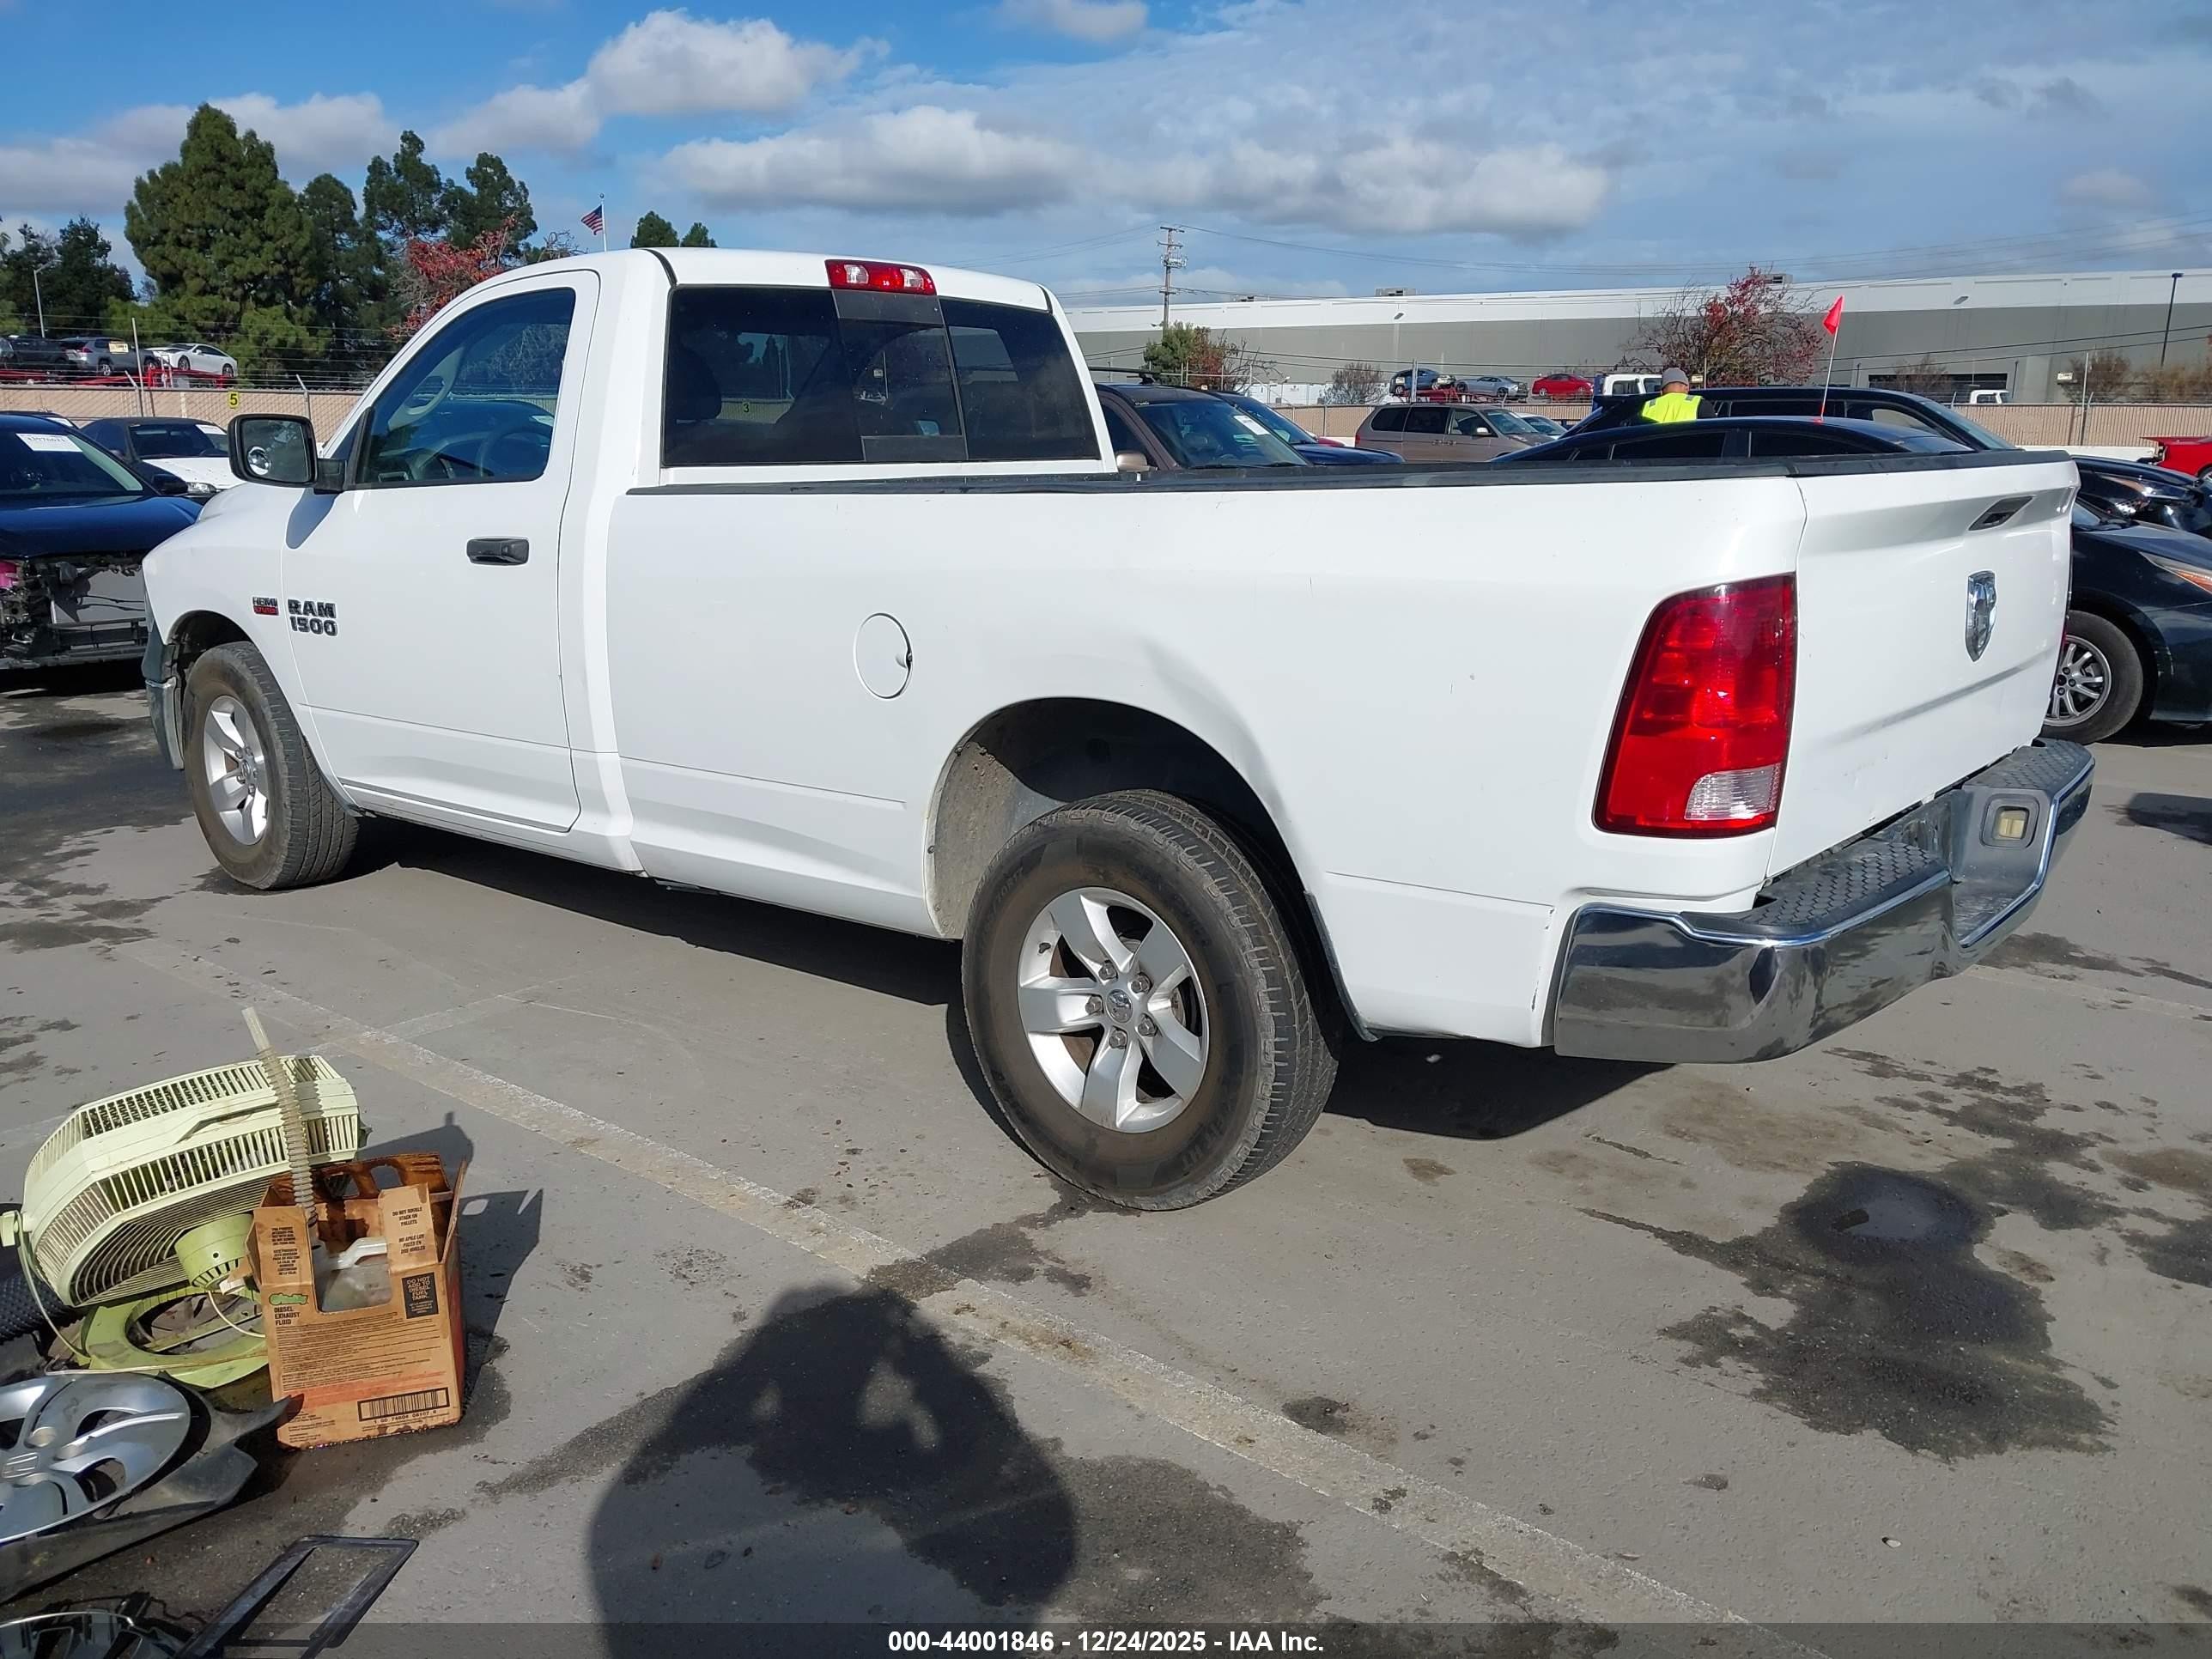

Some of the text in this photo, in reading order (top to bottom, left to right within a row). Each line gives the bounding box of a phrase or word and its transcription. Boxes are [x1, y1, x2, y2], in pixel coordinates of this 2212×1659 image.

[230, 393, 238, 406] 5
[743, 403, 750, 413] 3
[252, 597, 277, 606] HEMI
[287, 599, 337, 618] RAM
[289, 616, 337, 636] 1500
